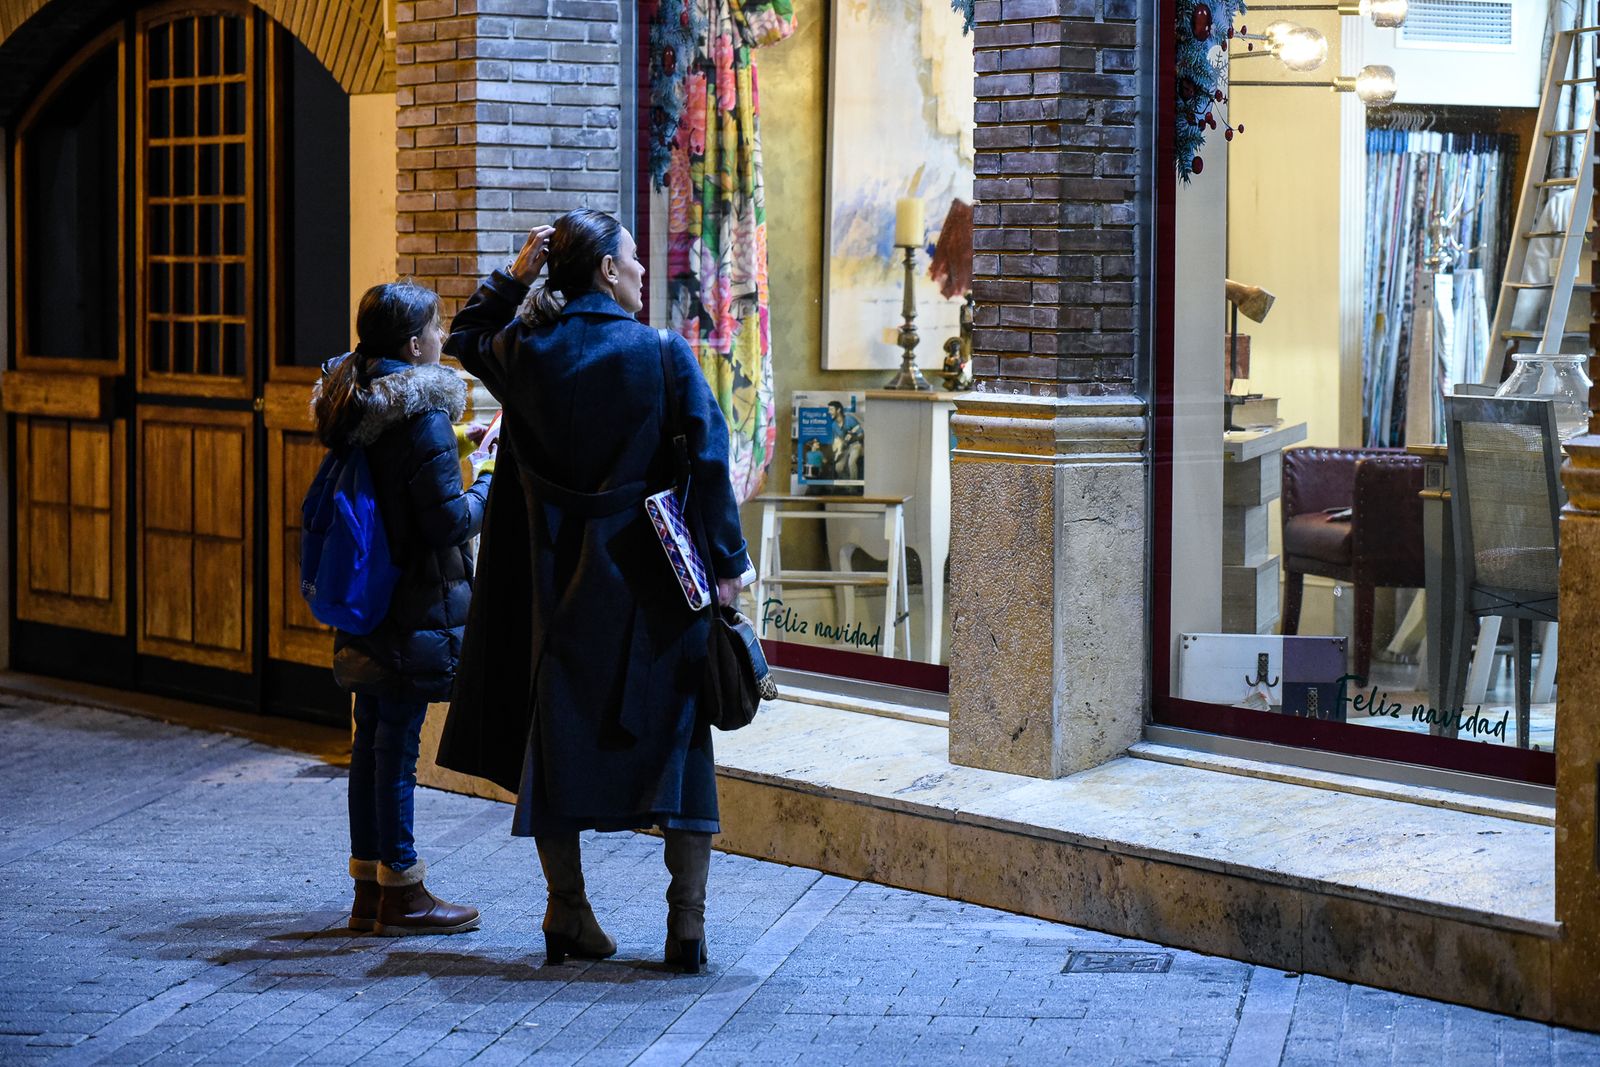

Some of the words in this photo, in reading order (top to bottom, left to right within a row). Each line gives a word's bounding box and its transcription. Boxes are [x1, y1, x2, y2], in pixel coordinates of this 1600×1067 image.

[762, 597, 808, 636] Feliz
[815, 621, 881, 653] navidad
[1335, 673, 1402, 719] Feliz
[1412, 704, 1509, 743] navidad
